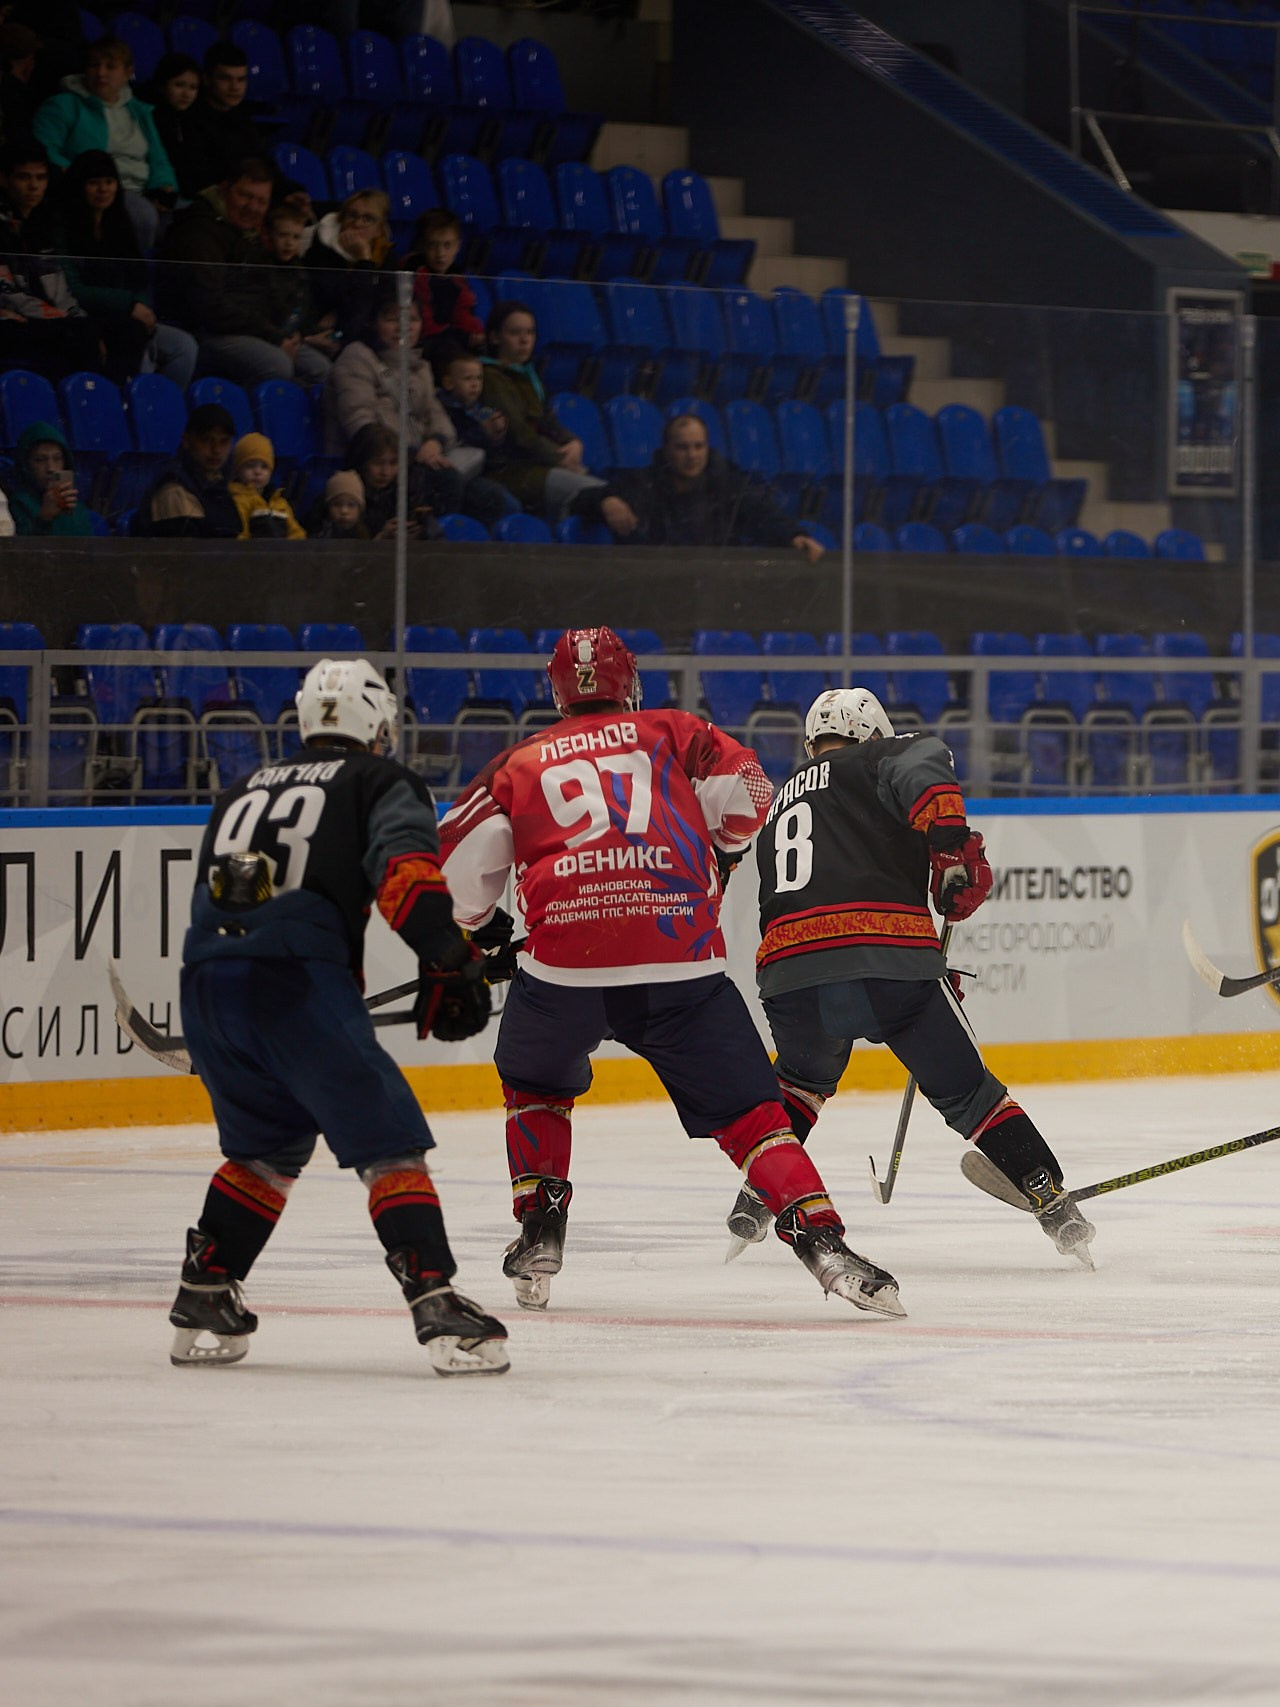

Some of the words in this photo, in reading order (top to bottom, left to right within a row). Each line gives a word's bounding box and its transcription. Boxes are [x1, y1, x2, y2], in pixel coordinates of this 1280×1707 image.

[540, 722, 638, 763] ЛЕОНОВ
[540, 750, 652, 849] 97
[208, 785, 327, 898] 93
[554, 845, 673, 878] ФЕНИКС
[774, 801, 814, 894] 8
[578, 880, 652, 896] ИВАНОВСКАЯ
[985, 866, 1133, 900] ИТЕЛЬСТВО
[602, 906, 624, 919] ГПС
[626, 904, 650, 916] МЧС
[652, 904, 695, 916] РОССИИ
[1098, 1138, 1247, 1193] SHERWOOD
